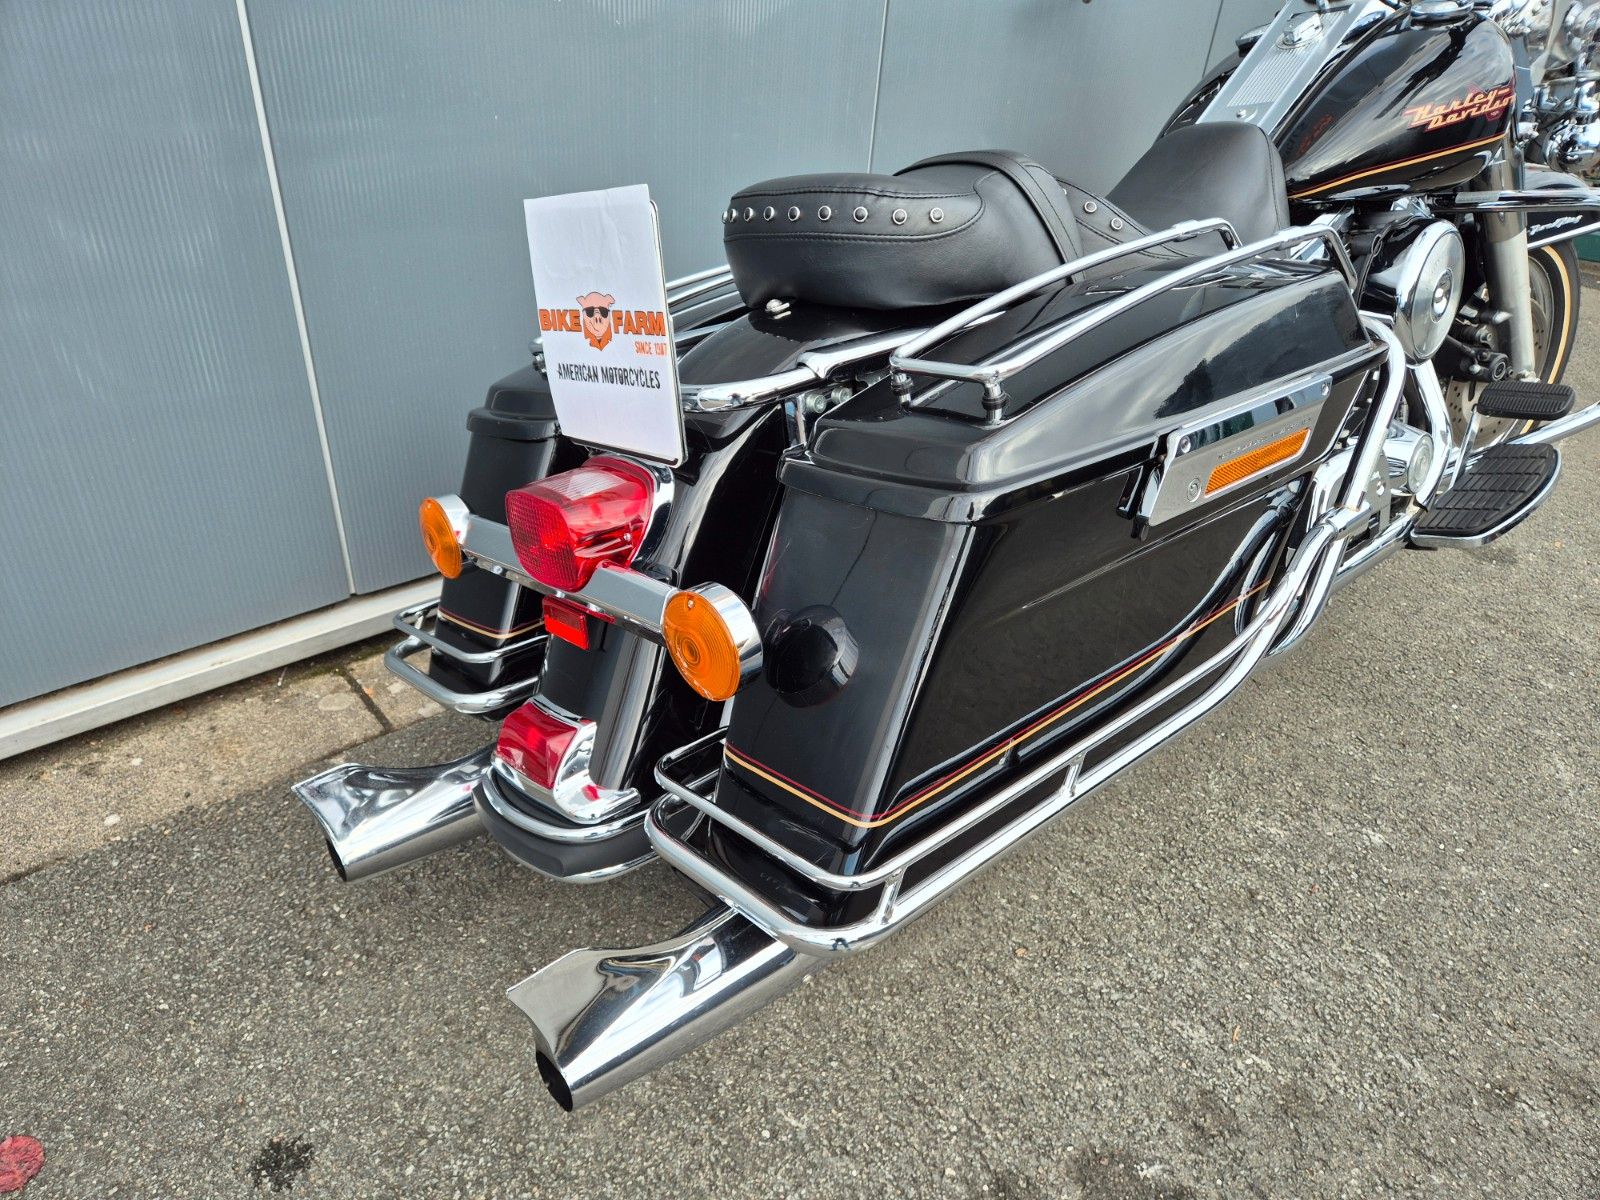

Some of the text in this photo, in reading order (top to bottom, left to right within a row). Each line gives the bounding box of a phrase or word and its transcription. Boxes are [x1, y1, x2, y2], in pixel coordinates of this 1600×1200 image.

[538, 308, 666, 336] BIKE FARM
[635, 340, 652, 355] SINCE
[557, 362, 661, 389] AMERICAN MOTORCYCLES
